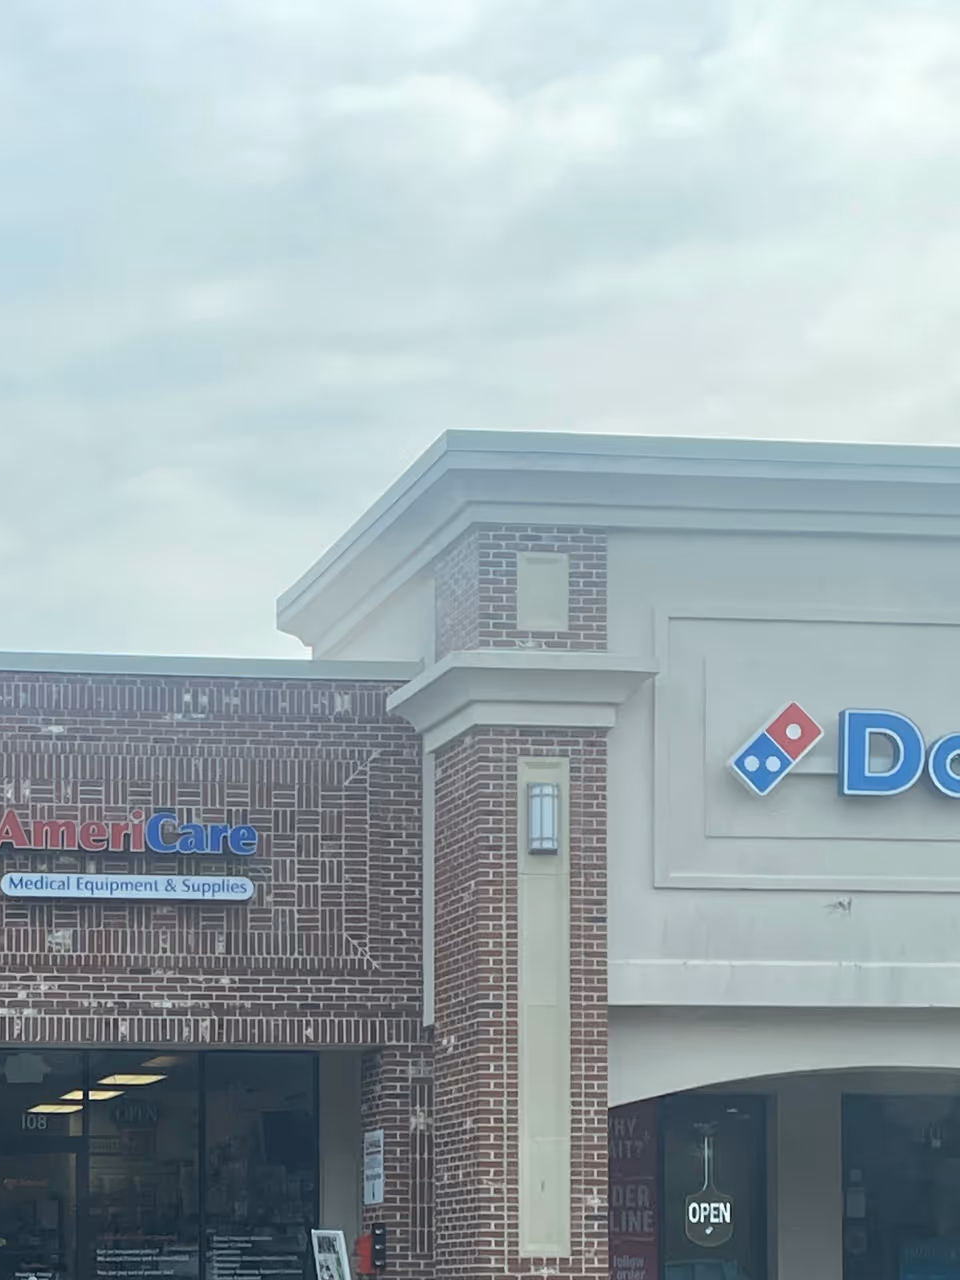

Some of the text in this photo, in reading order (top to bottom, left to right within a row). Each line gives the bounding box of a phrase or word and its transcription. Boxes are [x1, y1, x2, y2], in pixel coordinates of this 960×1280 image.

[8, 875, 248, 897] Medical Equipment & Supplies
[21, 1114, 47, 1130] 108
[688, 1202, 731, 1223] OPEN
